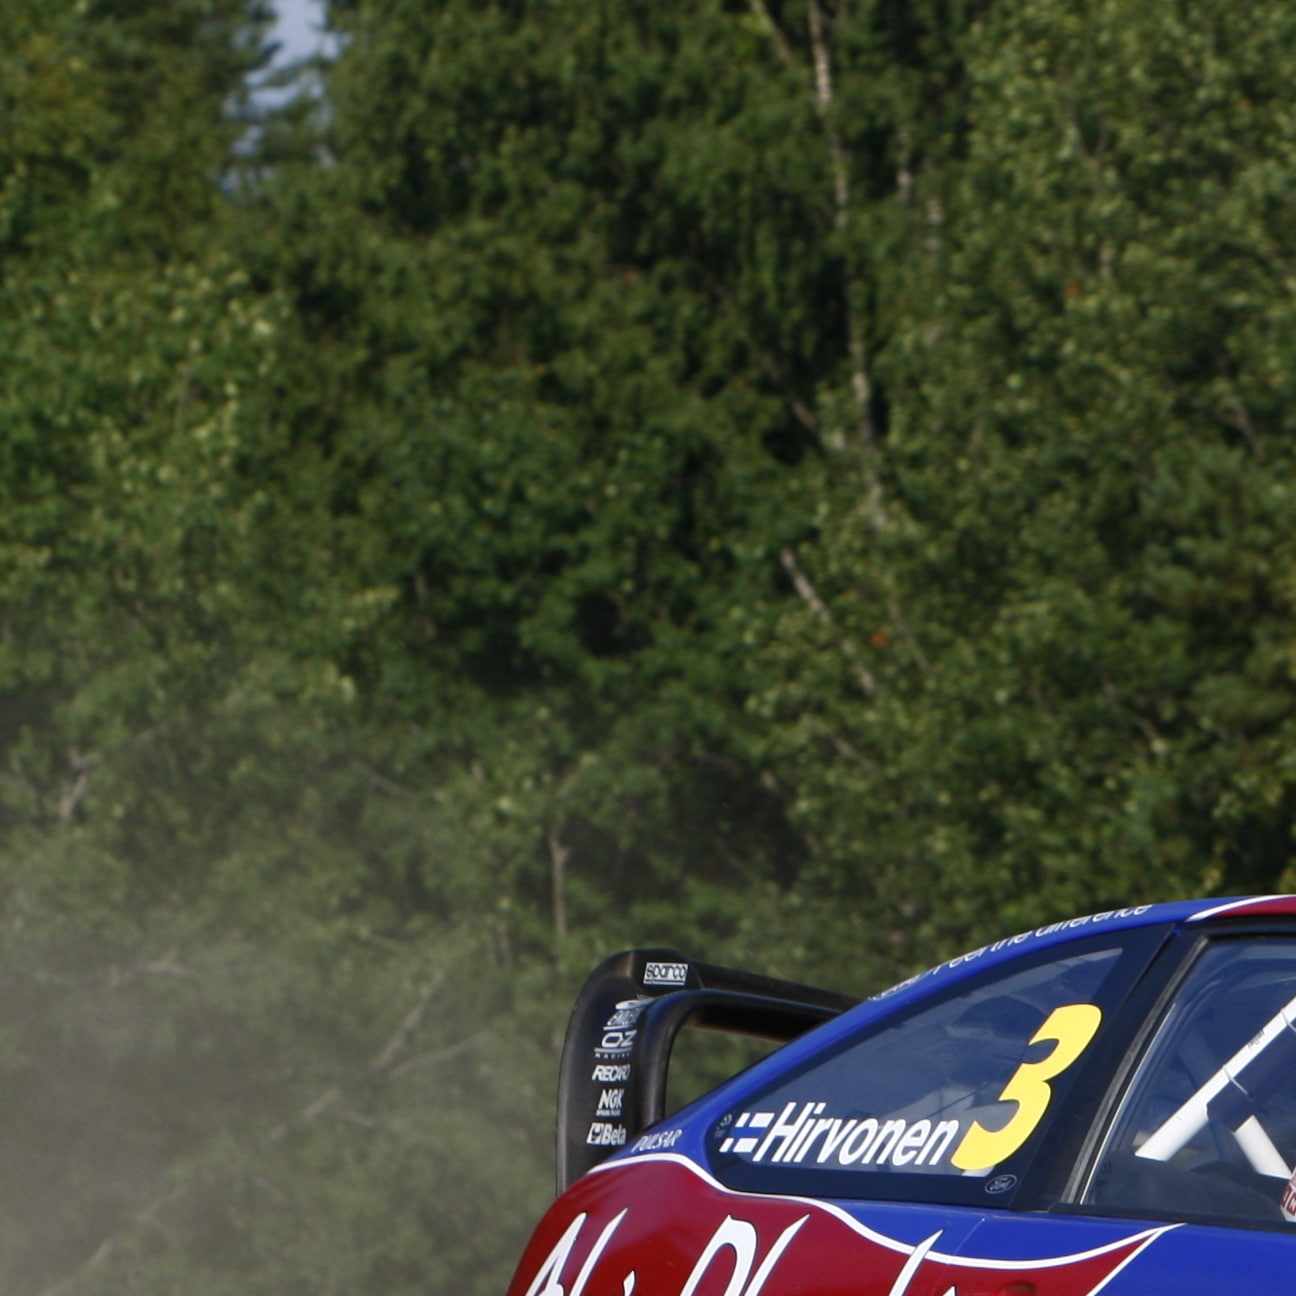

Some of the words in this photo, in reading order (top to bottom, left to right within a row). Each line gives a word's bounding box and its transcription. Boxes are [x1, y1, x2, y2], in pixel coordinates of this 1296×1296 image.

[645, 963, 688, 980] sparco
[601, 1029, 638, 1049] OZ
[592, 1064, 632, 1082] RECARO
[951, 1003, 1102, 1171] 3
[598, 1089, 625, 1110] NGK
[601, 1124, 628, 1146] Beta
[752, 1100, 960, 1168] Hirvonen
